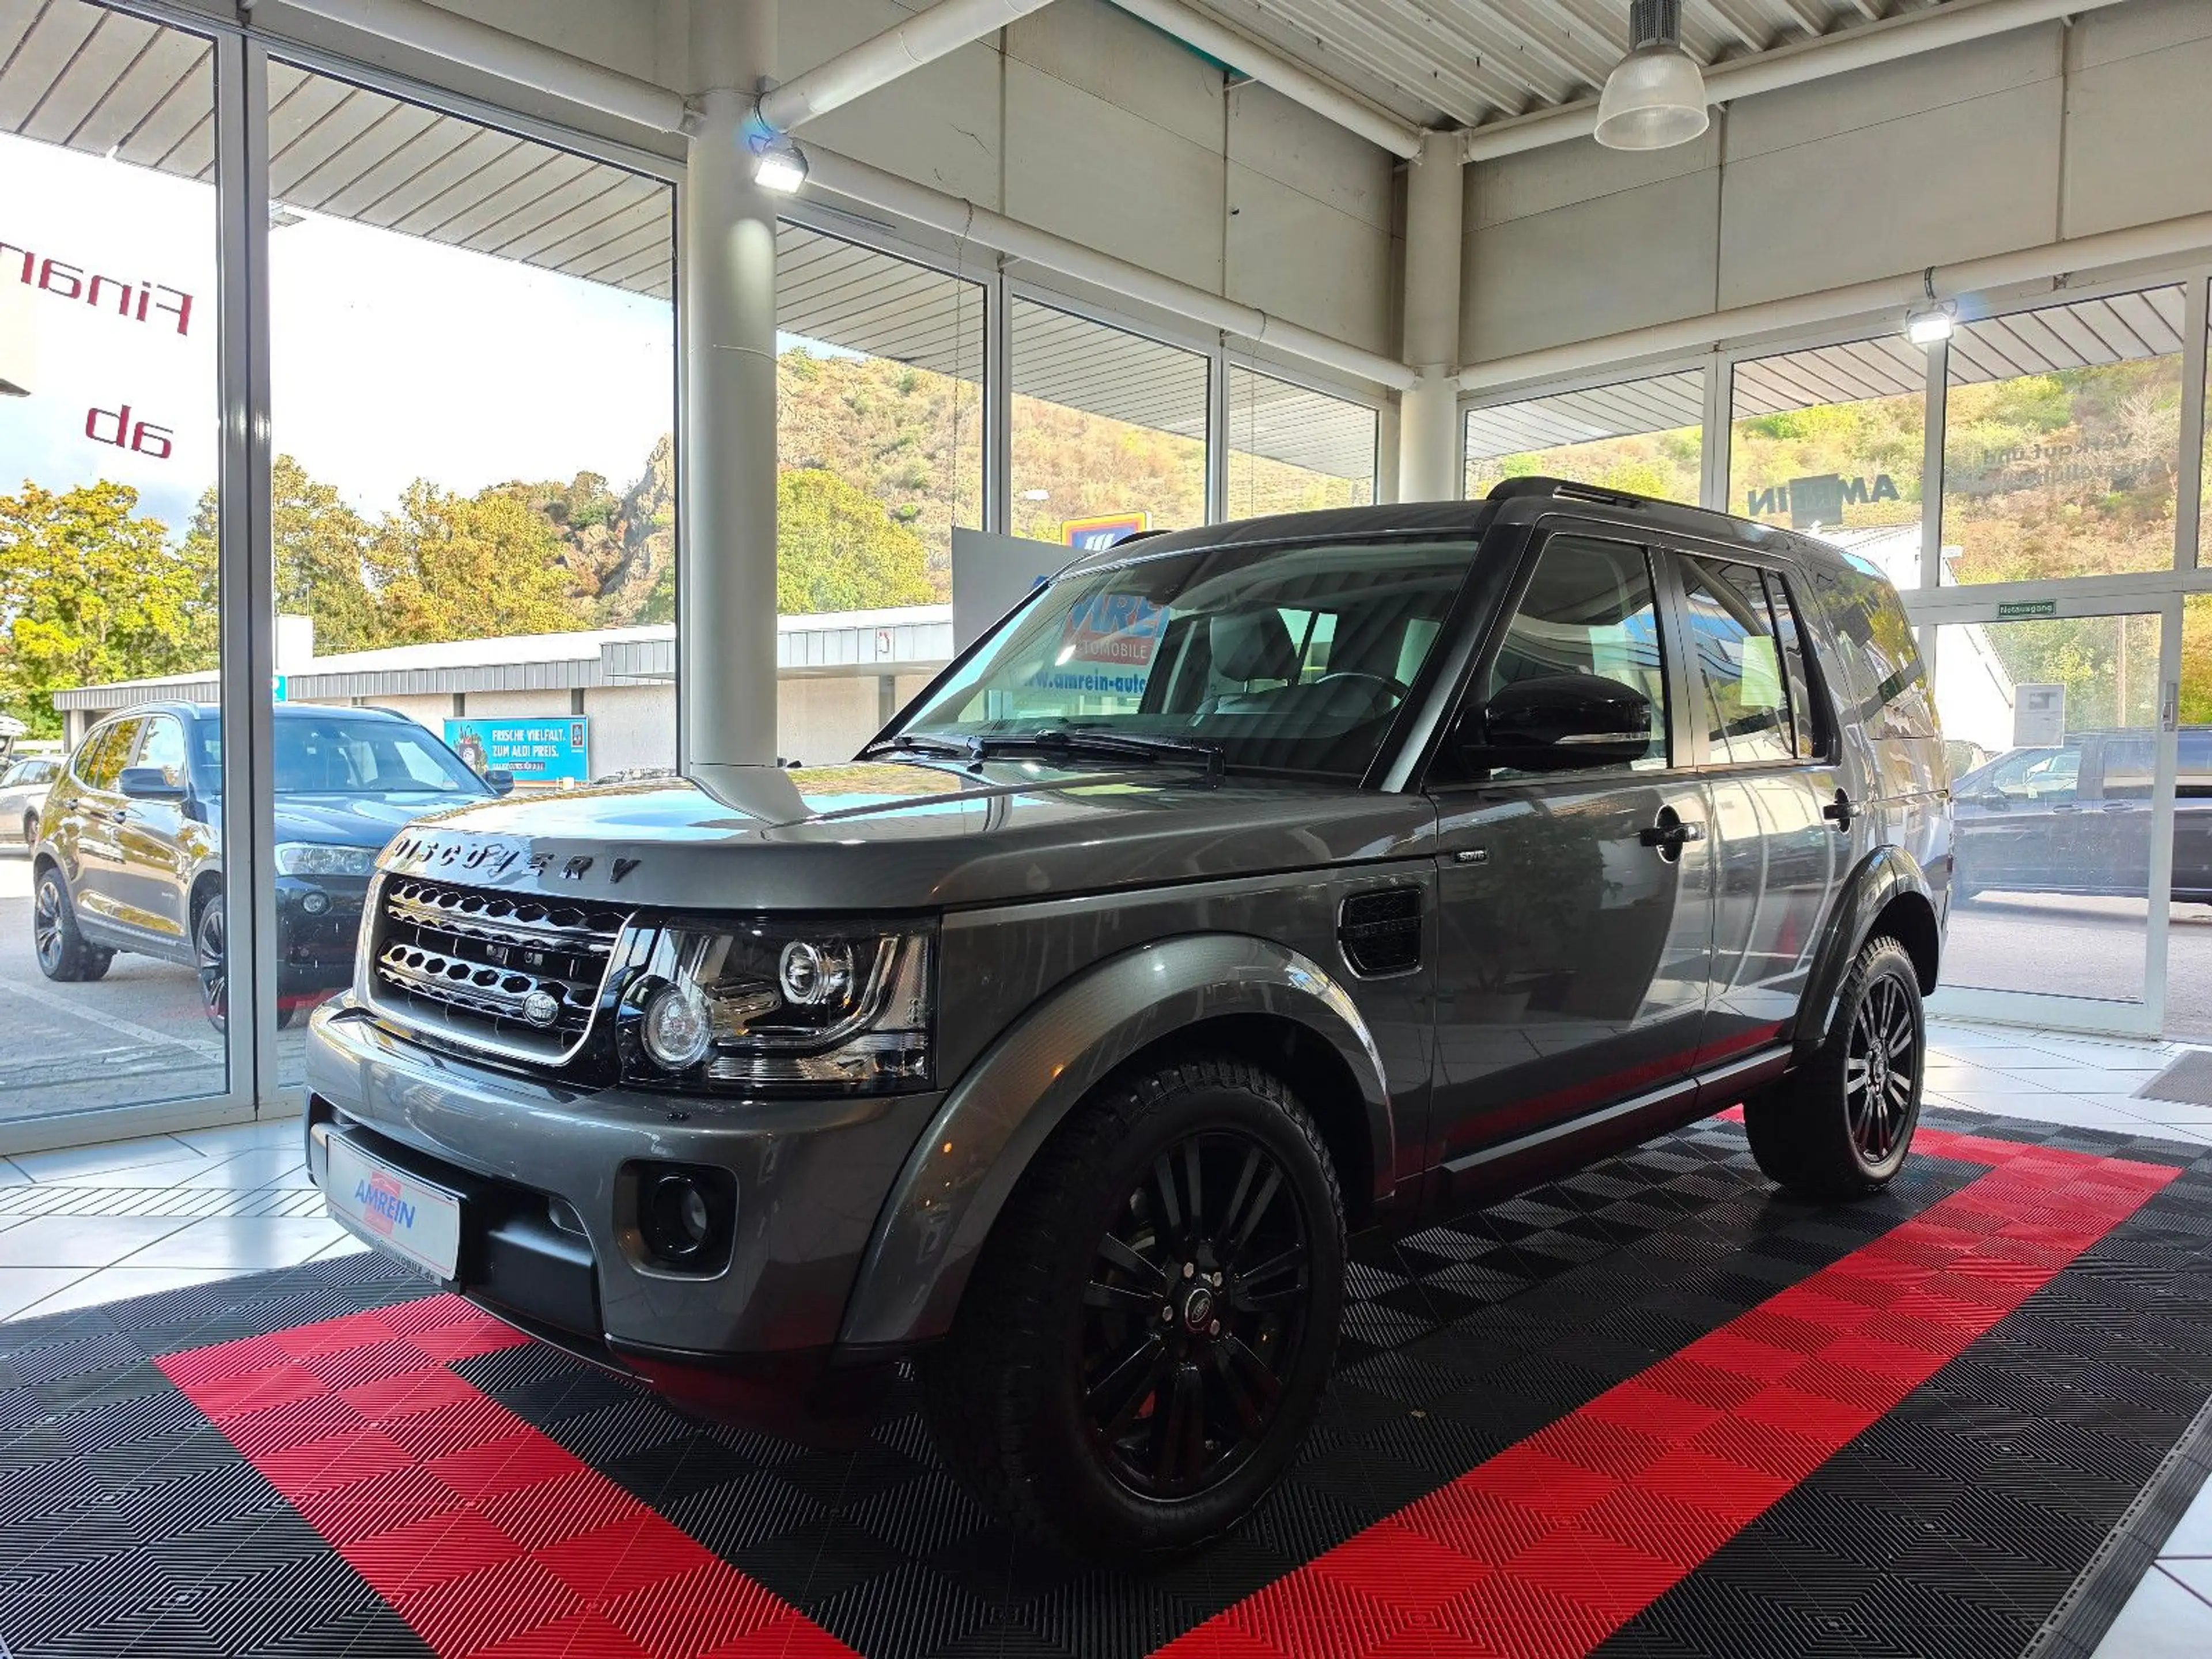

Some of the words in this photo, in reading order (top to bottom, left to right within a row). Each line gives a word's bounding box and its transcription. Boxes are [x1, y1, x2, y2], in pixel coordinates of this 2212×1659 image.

[2000, 605, 2052, 613] Notausgang
[493, 729, 524, 741] FRISCHE
[527, 729, 566, 741] VIELFALT.
[493, 745, 509, 757] ZUM
[512, 745, 531, 757] ALDI
[532, 745, 559, 757] PREIS.
[355, 1179, 416, 1229] AMREIN
